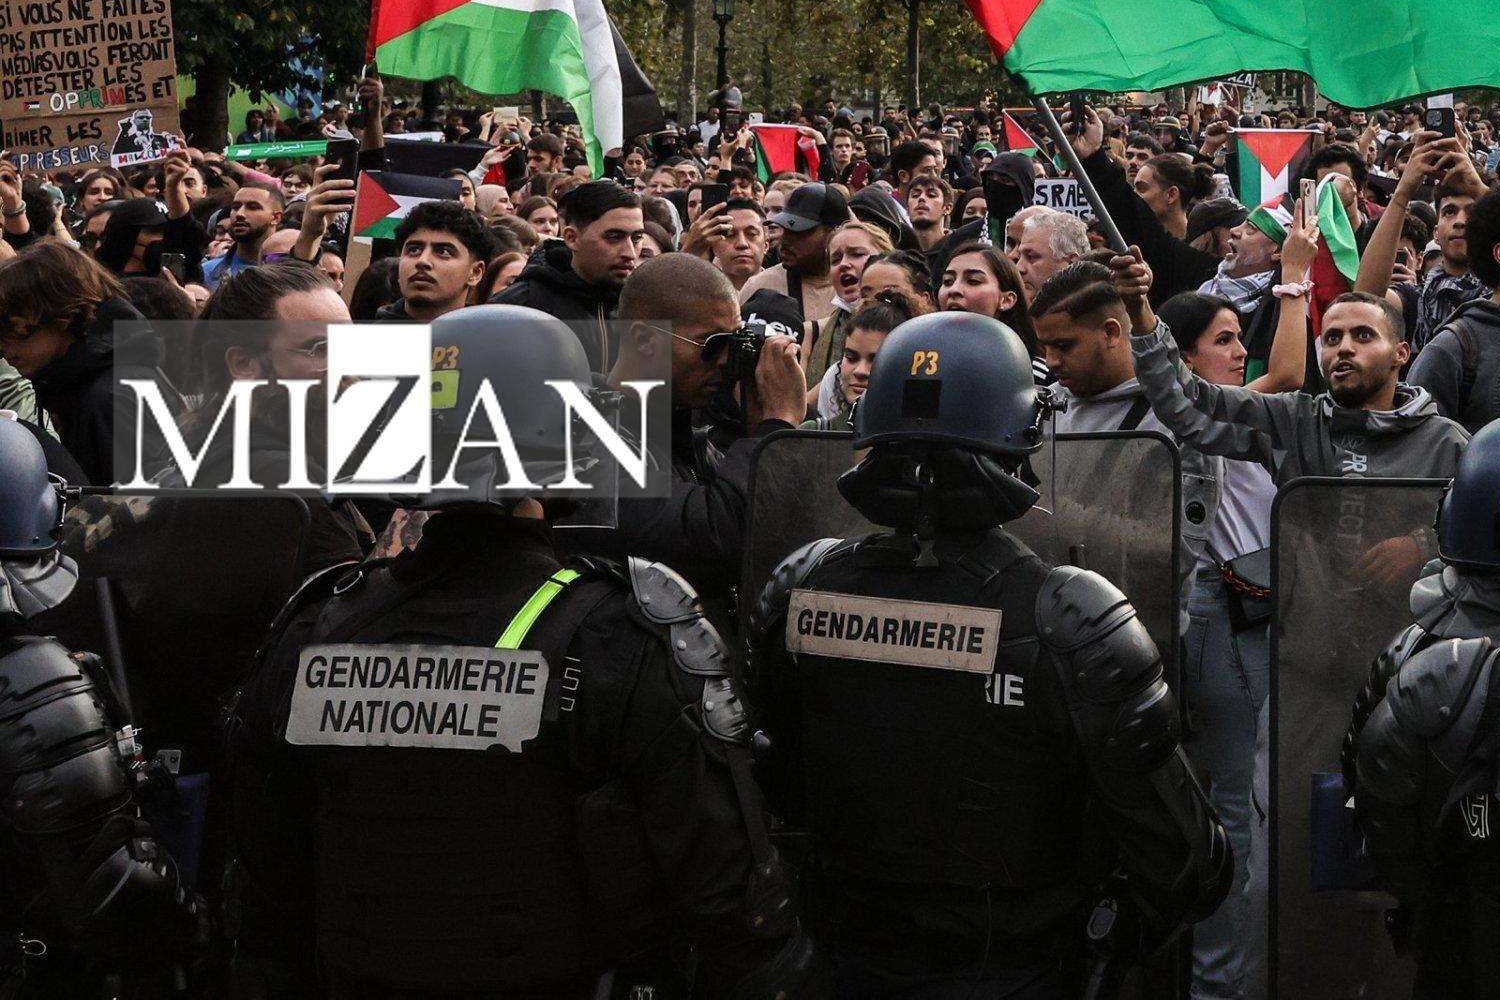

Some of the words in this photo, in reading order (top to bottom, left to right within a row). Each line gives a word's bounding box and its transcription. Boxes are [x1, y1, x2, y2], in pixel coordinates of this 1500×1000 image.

[19, 0, 62, 26] VOUS
[0, 31, 25, 53] PAS
[138, 16, 170, 39] LES
[53, 47, 99, 70] VOUS
[108, 38, 172, 65] FERONT
[3, 69, 95, 100] DÉTESTER
[103, 62, 142, 86] LES
[152, 75, 173, 98] ET
[67, 118, 103, 142] LES
[1036, 184, 1088, 208] SRAE
[431, 345, 460, 370] P3
[911, 351, 939, 375] P3
[797, 608, 985, 654] GENDARMERIE
[305, 655, 539, 695] GENDARMERIE
[319, 700, 502, 737] NATIONALE
